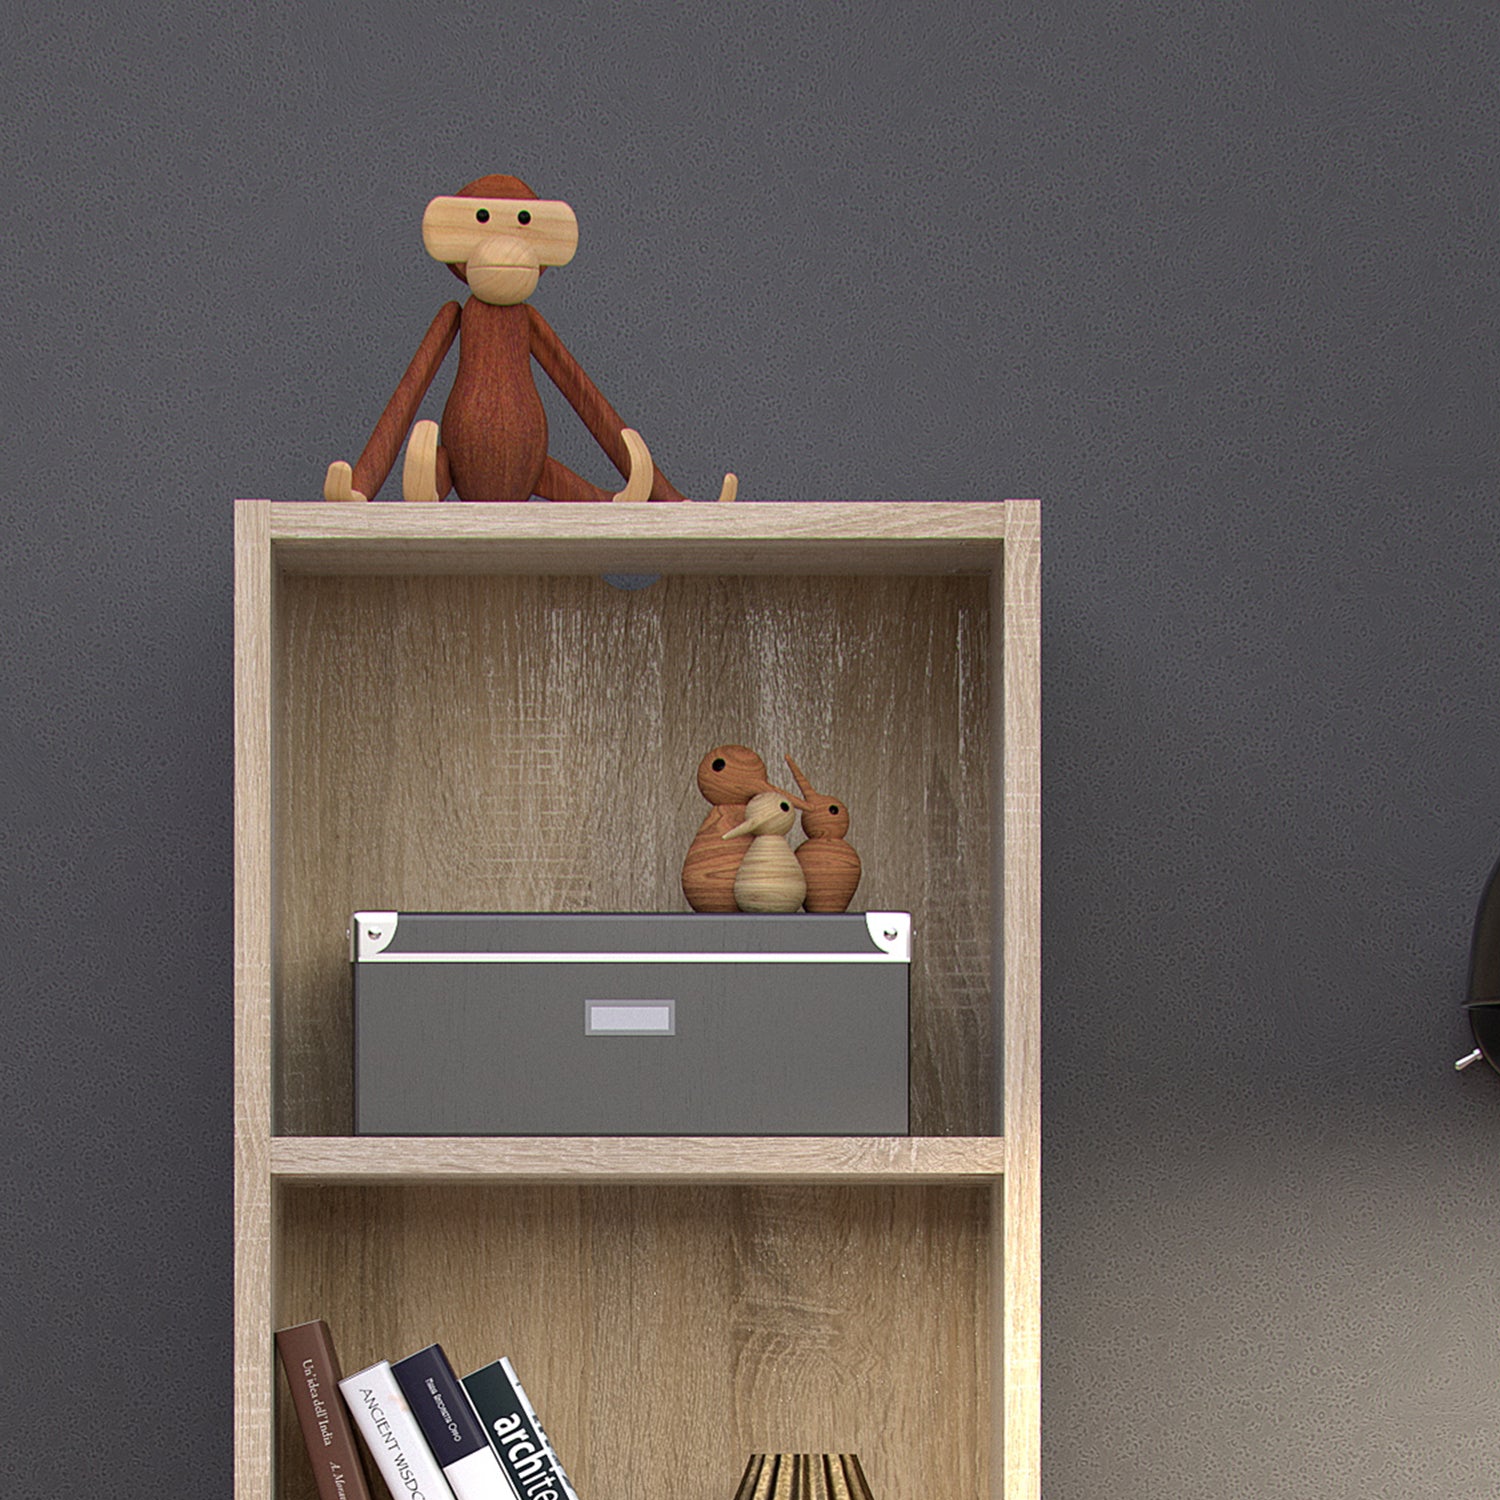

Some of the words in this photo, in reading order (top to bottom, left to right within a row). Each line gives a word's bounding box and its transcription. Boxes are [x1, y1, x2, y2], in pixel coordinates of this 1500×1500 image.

[302, 1358, 318, 1398] Un'idea
[313, 1399, 333, 1446] dell'India
[359, 1388, 400, 1450] ANCIENT
